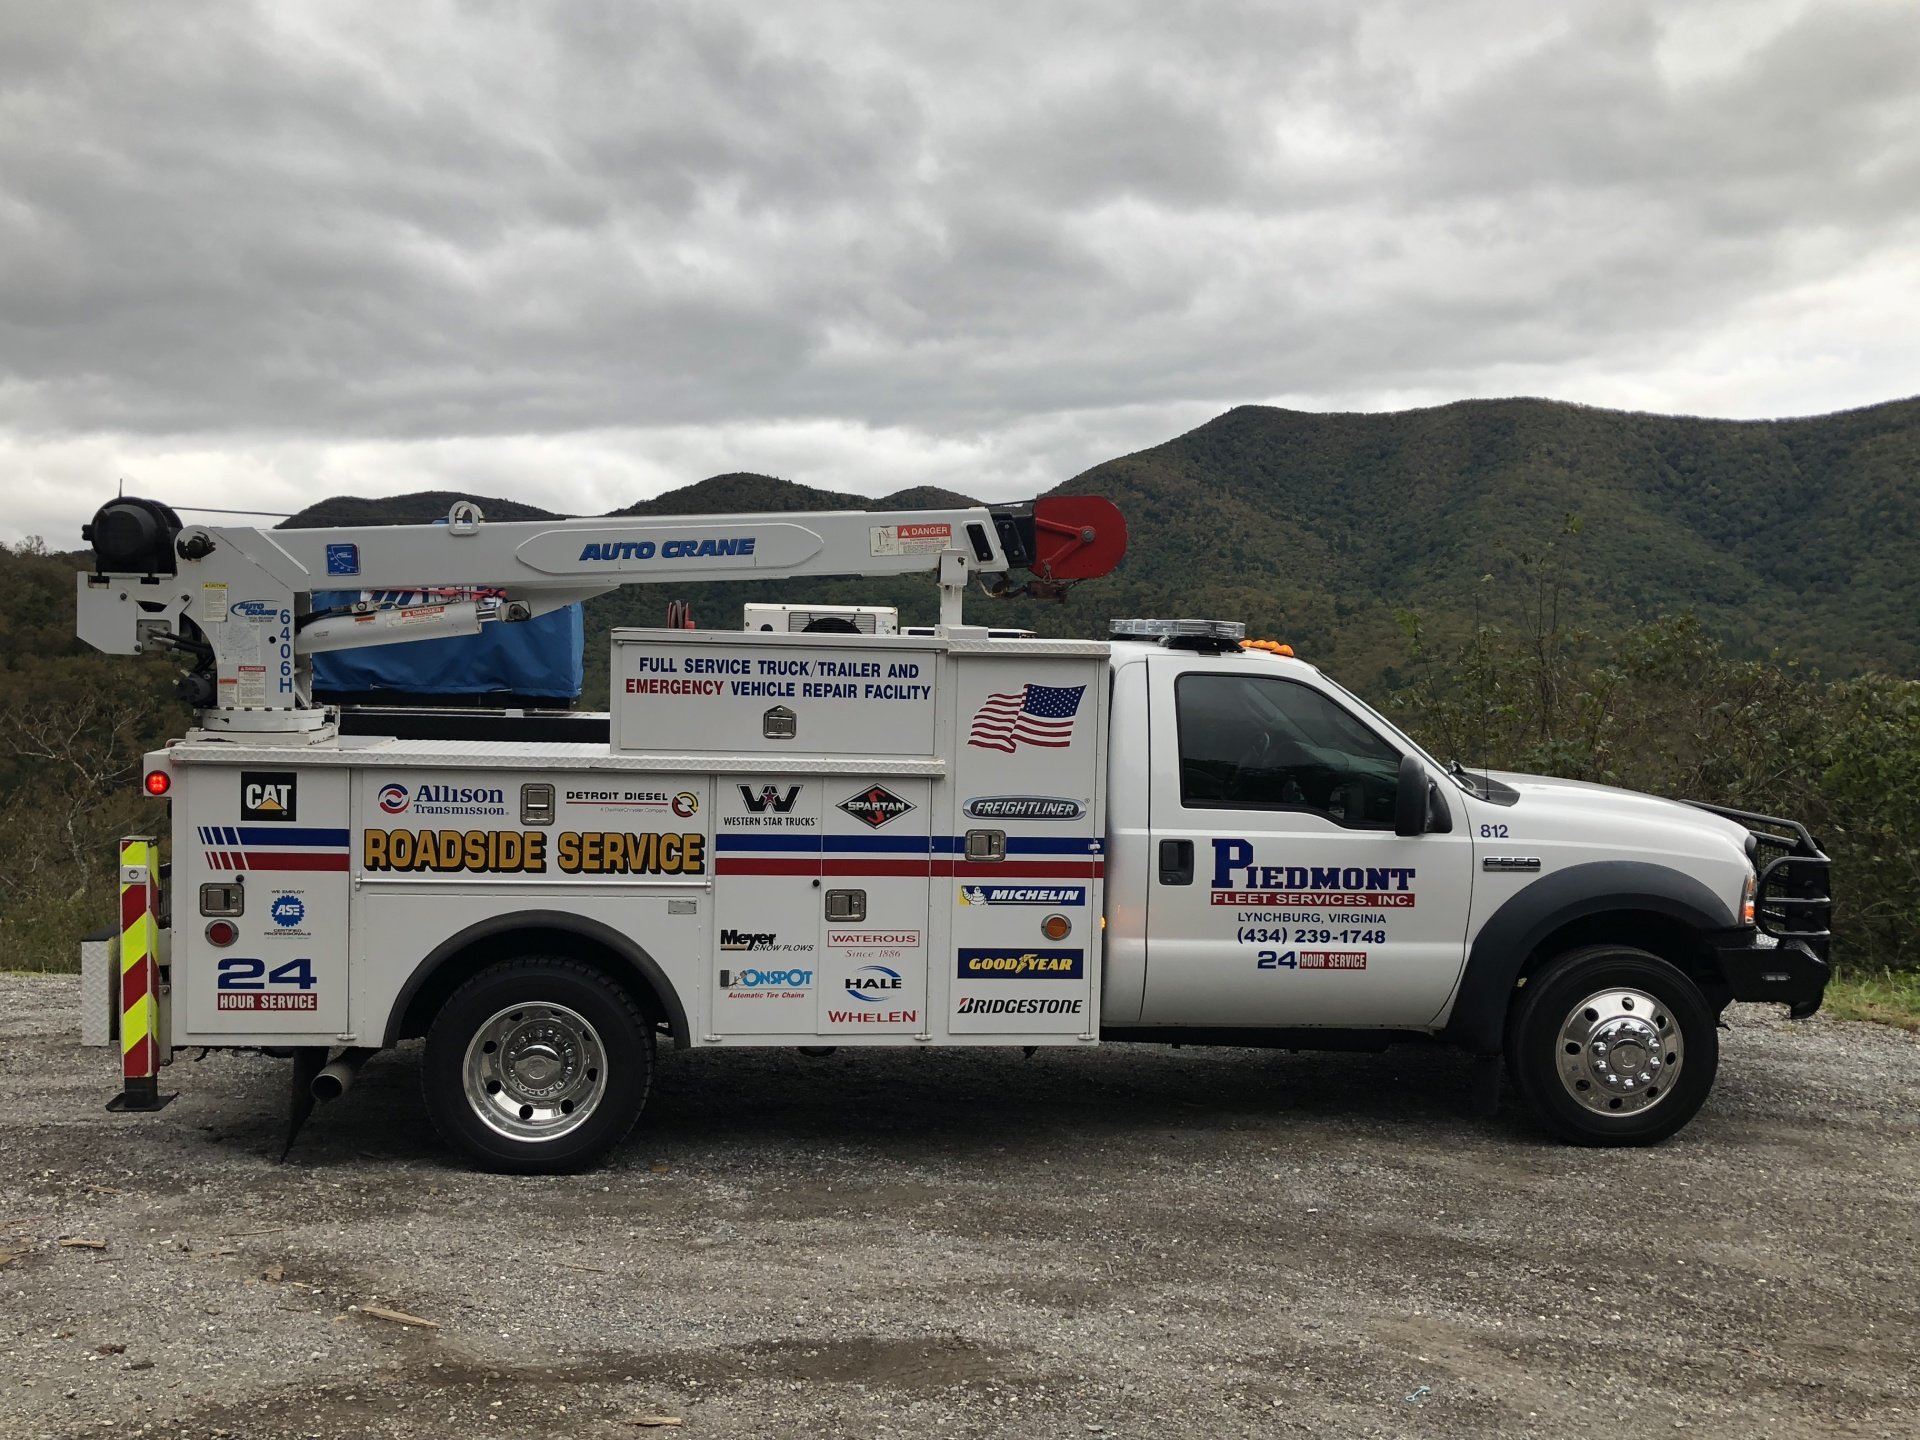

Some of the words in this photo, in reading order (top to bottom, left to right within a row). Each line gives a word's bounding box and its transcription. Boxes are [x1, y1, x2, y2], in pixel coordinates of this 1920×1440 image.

[911, 526, 948, 535] DANGER
[579, 541, 655, 562] AUTO
[661, 538, 756, 558] CRANE
[412, 607, 441, 616] DANGER
[280, 609, 293, 693] 6406H
[639, 657, 677, 673] FULL
[684, 658, 751, 675] SERVICE
[758, 659, 881, 678] TRUCK/TRAILER
[888, 663, 919, 679] AND
[625, 678, 724, 696] EMERGENCY
[731, 681, 796, 697] VEHICLE
[802, 682, 857, 699] REPAIR
[864, 684, 932, 700] FACILITY
[246, 784, 292, 810] CAT
[413, 784, 504, 804] Allison
[566, 791, 619, 800] DETROIT
[624, 792, 668, 801] DIESEL
[413, 804, 506, 816] Transmission
[847, 801, 905, 812] SPARTAN
[975, 801, 1075, 817] FREIGHTLINER
[724, 816, 761, 827] WESTERN
[763, 817, 784, 827] STAR
[785, 817, 816, 827] TRUCKS
[1480, 824, 1509, 838] 812
[363, 828, 547, 874] ROADSIDE
[558, 831, 705, 875] SERVICE
[1211, 838, 1416, 891] PIEDMONT
[990, 889, 1079, 901] MICHELIN
[1212, 893, 1270, 905] FLEET
[1275, 894, 1372, 907] SERVICES,
[1378, 895, 1414, 907] INC.
[275, 904, 300, 916] ASE
[1237, 912, 1324, 925] LYNCHBURG,
[1328, 913, 1387, 924] VIRGINIA
[720, 929, 777, 951] Meyer
[831, 934, 916, 943] WATEROUS
[1237, 927, 1288, 945] (434)
[1295, 929, 1386, 944] 239-1748
[753, 944, 783, 952] SNOW
[783, 944, 815, 952] PLOWS
[845, 949, 874, 959] Since
[878, 949, 901, 958] 1886
[1257, 950, 1297, 969] 24
[1301, 954, 1325, 968] HOUR
[1328, 954, 1365, 968] SERVICE
[218, 958, 318, 990] 24
[742, 968, 813, 987] ONSPOT
[845, 978, 902, 989] HALE
[220, 994, 255, 1009] HOUR
[260, 994, 315, 1009] SERVICE
[957, 997, 1083, 1014] BRIDGESTONE
[828, 1010, 918, 1023] WHELEN
